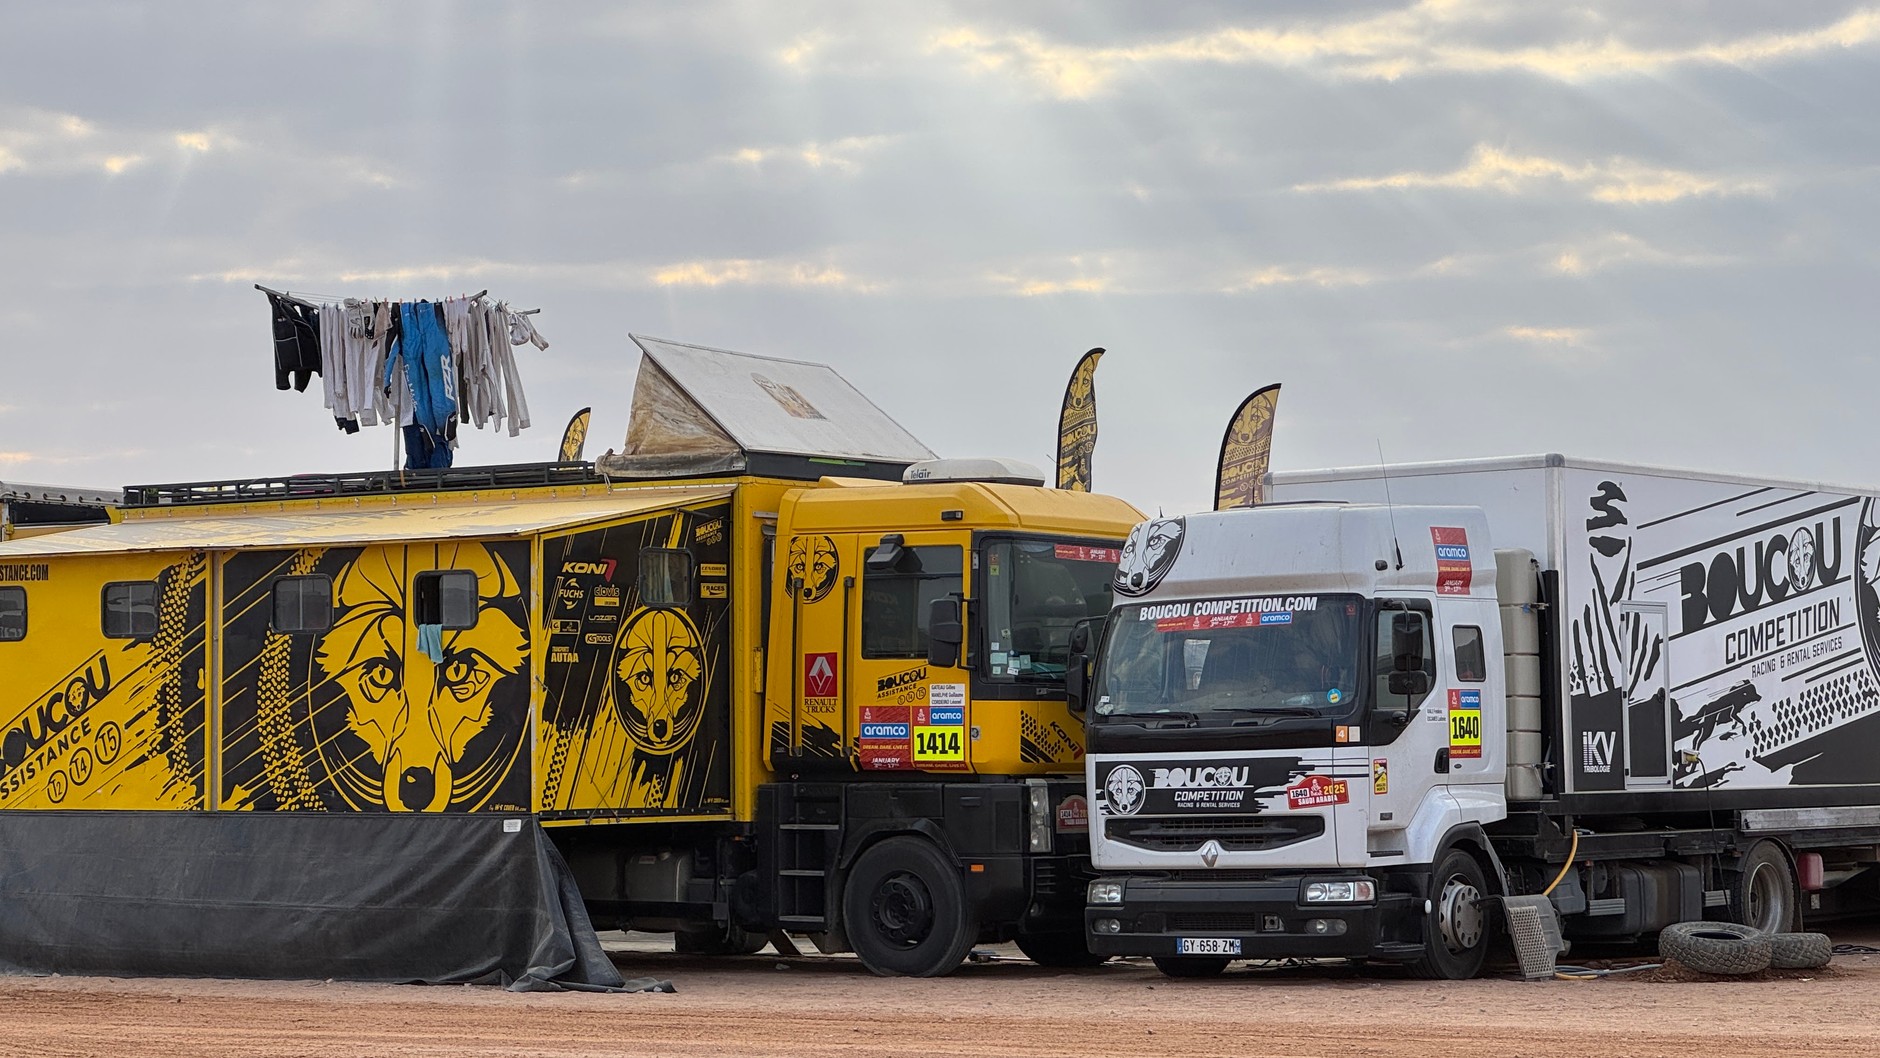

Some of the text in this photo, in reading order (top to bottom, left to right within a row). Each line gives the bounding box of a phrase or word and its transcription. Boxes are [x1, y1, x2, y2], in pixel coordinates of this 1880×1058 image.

[1438, 547, 1467, 558] aramco
[562, 562, 608, 575] KONI
[1681, 515, 1841, 633] BOUCOU
[558, 588, 585, 599] FUCHS
[1139, 596, 1318, 621] BOUCOU COMPETITION.COM
[1262, 614, 1290, 622] aramco
[1725, 596, 1840, 665] COMPETITION
[551, 652, 579, 663] AUTAA
[1751, 636, 1842, 678] RACING & RENTAL SERVICES
[877, 667, 927, 692] BOUCOU
[877, 683, 917, 699] ASSISTANCE
[804, 698, 838, 706] RENAULT
[806, 705, 836, 713] TRUCKS
[0, 655, 111, 778] OUCOU
[931, 712, 962, 720] aramco
[864, 726, 906, 735] aramco
[1451, 716, 1479, 739] 1640
[1050, 721, 1078, 752] KONI
[1338, 729, 1345, 738] 4
[917, 732, 960, 755] 1414
[1583, 765, 1611, 773] TRIBOLOGIE
[1152, 766, 1249, 788] BOUCOU
[1291, 789, 1308, 798] 1640
[1323, 783, 1345, 795] 2025
[1174, 791, 1244, 801] COMPETITION
[1298, 794, 1338, 805] SAUDI ARABIA
